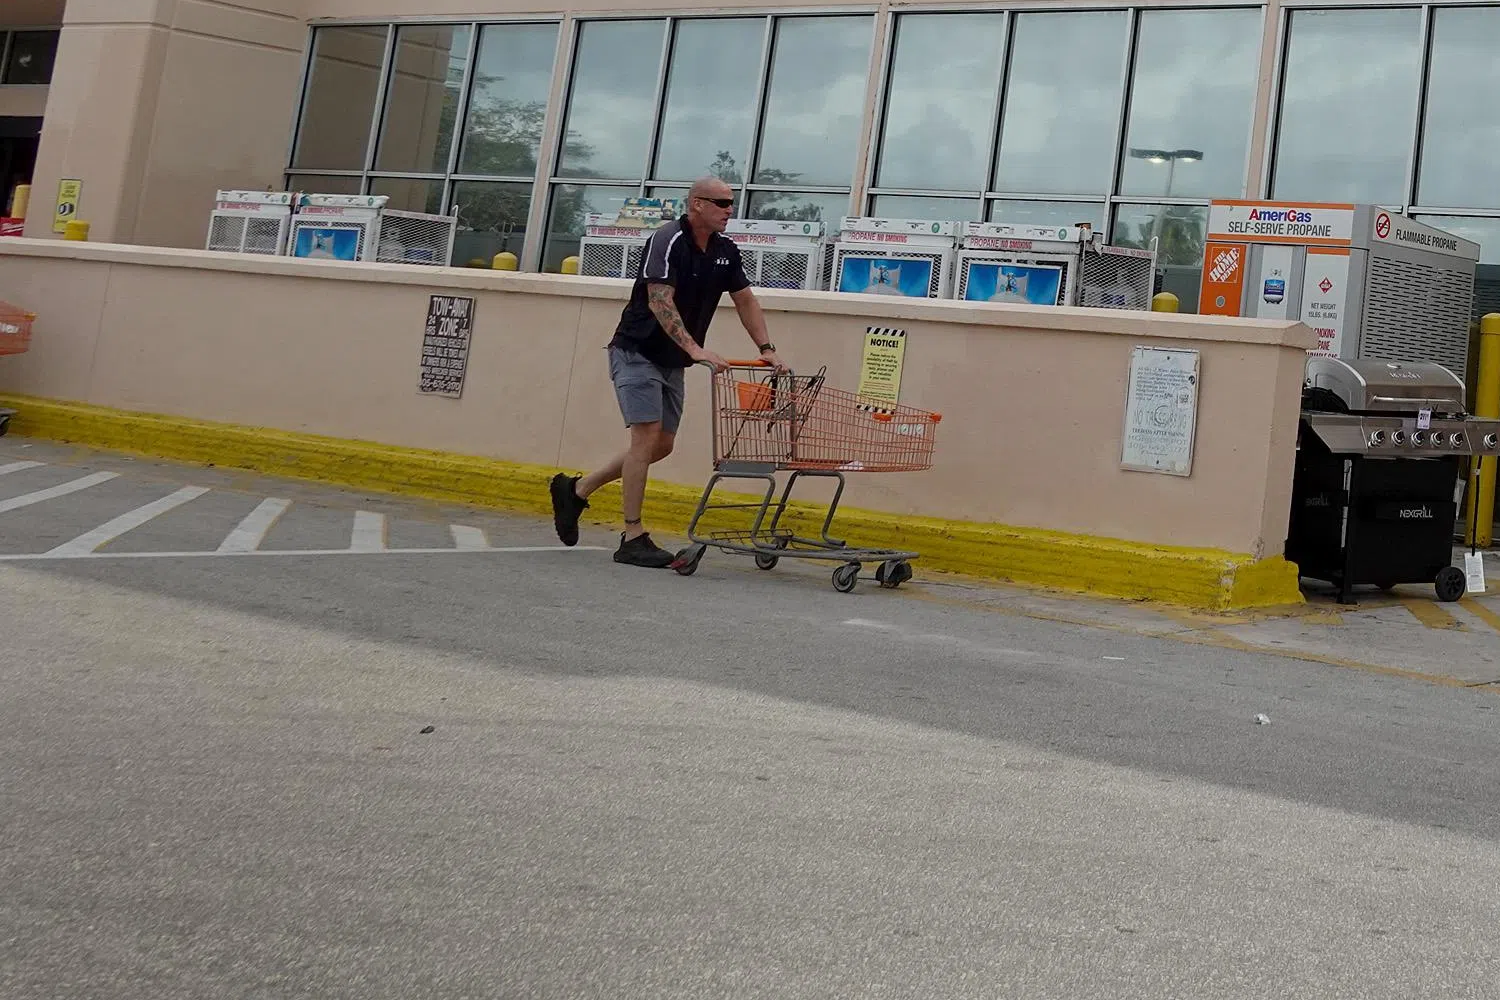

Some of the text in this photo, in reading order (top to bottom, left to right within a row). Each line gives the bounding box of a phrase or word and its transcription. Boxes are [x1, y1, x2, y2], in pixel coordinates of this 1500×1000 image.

[1249, 208, 1312, 223] AmeriGas
[617, 228, 641, 237] PROPANE
[1228, 221, 1331, 237] SELF-SERVE PROPANE
[749, 235, 777, 244] PROPANE
[884, 233, 908, 244] SMOKING
[970, 236, 1000, 248] PROPANE
[1009, 239, 1033, 250] SMOKING
[1395, 228, 1458, 251] FLAMMABLE PROPANE
[1209, 247, 1240, 282] THE HOME DEPOT
[432, 297, 470, 318] TOW-AWAY
[1311, 302, 1320, 310] NET
[438, 317, 459, 337] ZONE
[462, 318, 468, 329] 7
[870, 338, 899, 349] NOTICE!
[1318, 340, 1330, 351] PANE
[1399, 505, 1433, 518] NEXGRILL
